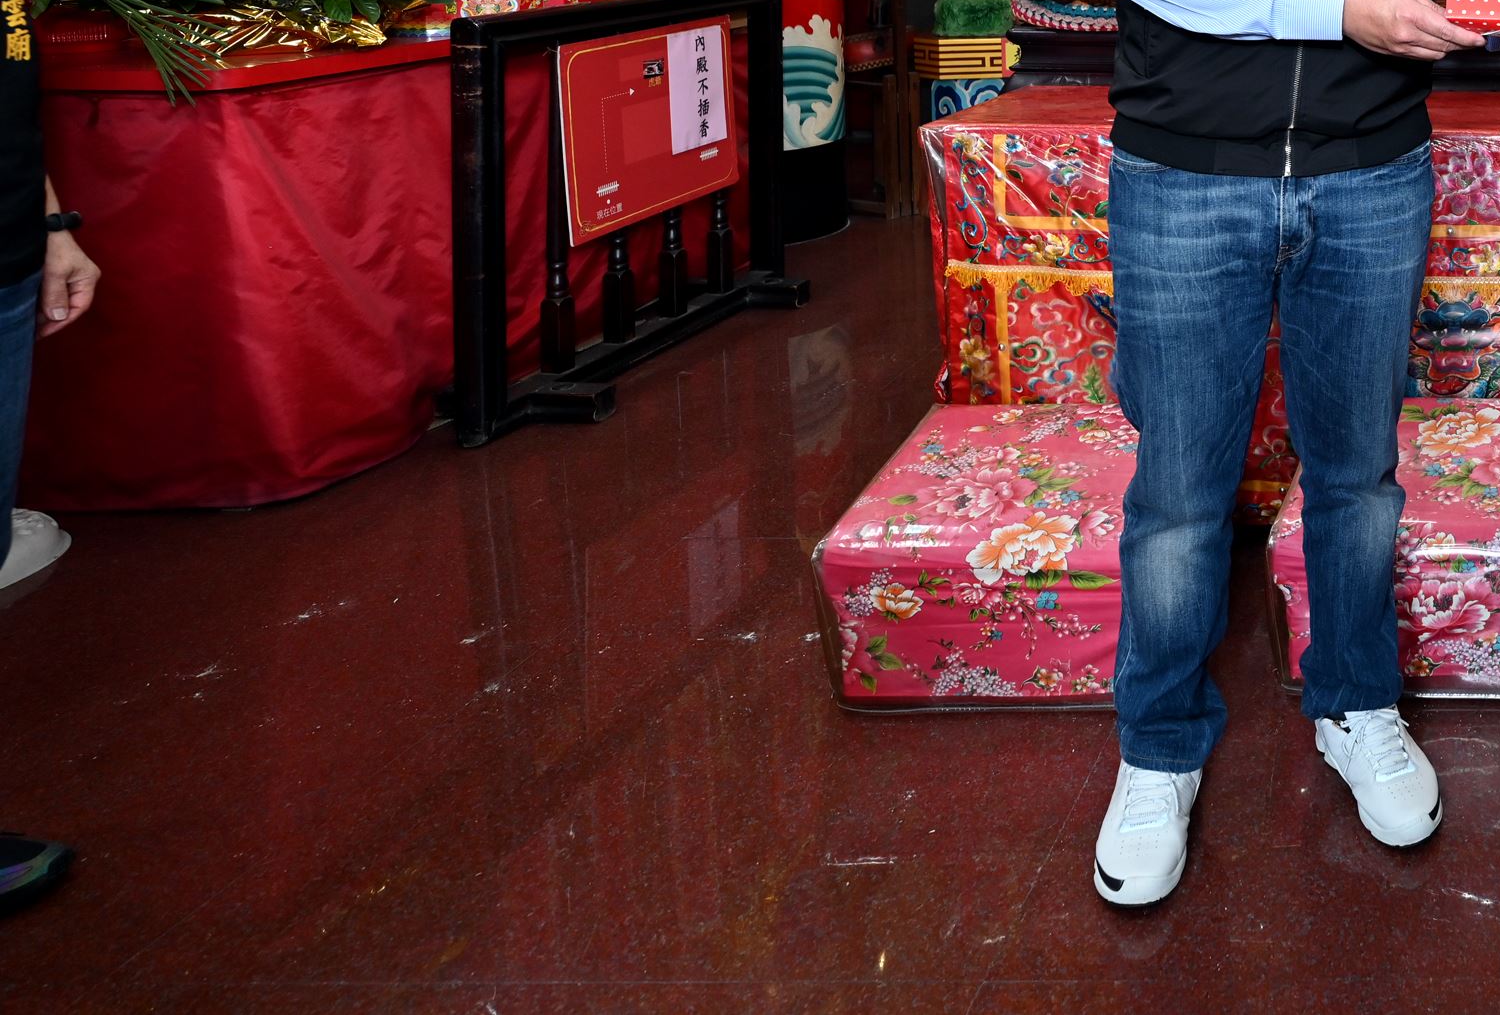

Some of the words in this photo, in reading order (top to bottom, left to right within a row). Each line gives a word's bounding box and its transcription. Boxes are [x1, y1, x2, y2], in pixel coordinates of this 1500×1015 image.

[695, 35, 710, 138] 內殿不插香
[595, 202, 623, 220] 現在位置
